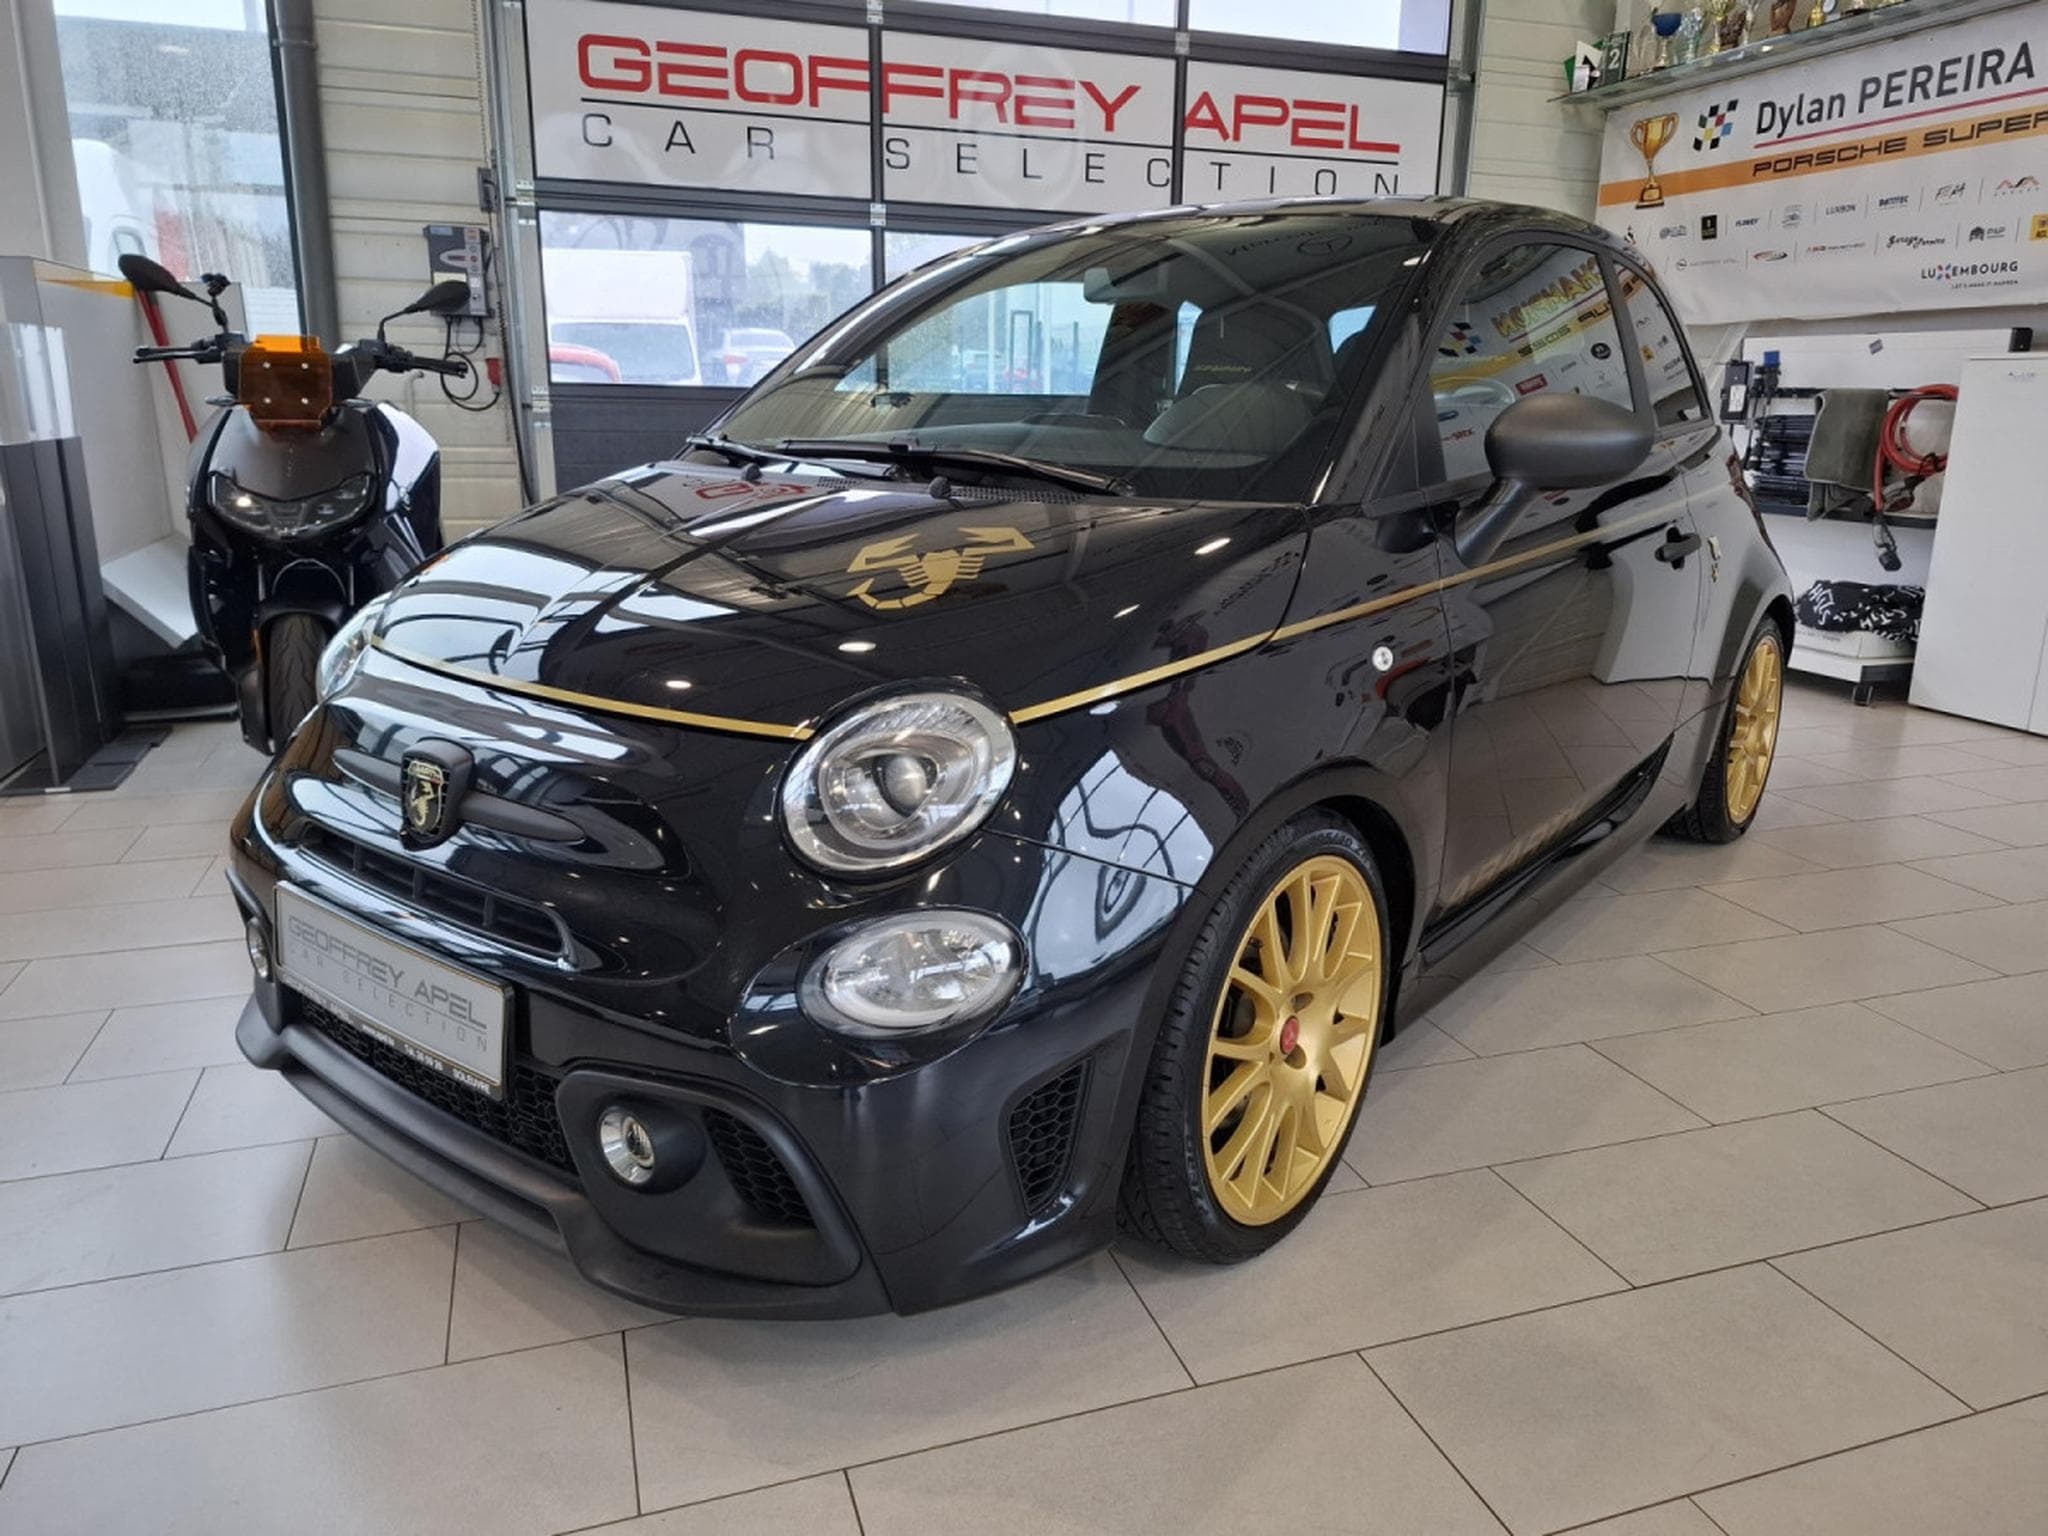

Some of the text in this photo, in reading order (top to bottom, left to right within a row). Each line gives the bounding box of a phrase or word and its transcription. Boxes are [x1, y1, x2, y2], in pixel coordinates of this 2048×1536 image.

[577, 33, 1401, 154] GEOFFREY APEL
[1608, 48, 1620, 70] 2
[1756, 40, 2035, 139] Dylan PEREIRA
[582, 112, 1399, 196] CAR SELECTION
[1752, 137, 1908, 177] PORSCHE
[1920, 260, 2018, 280] LUXEMBOURG
[288, 914, 405, 988] GEOFFREY
[413, 979, 488, 1031] APEL
